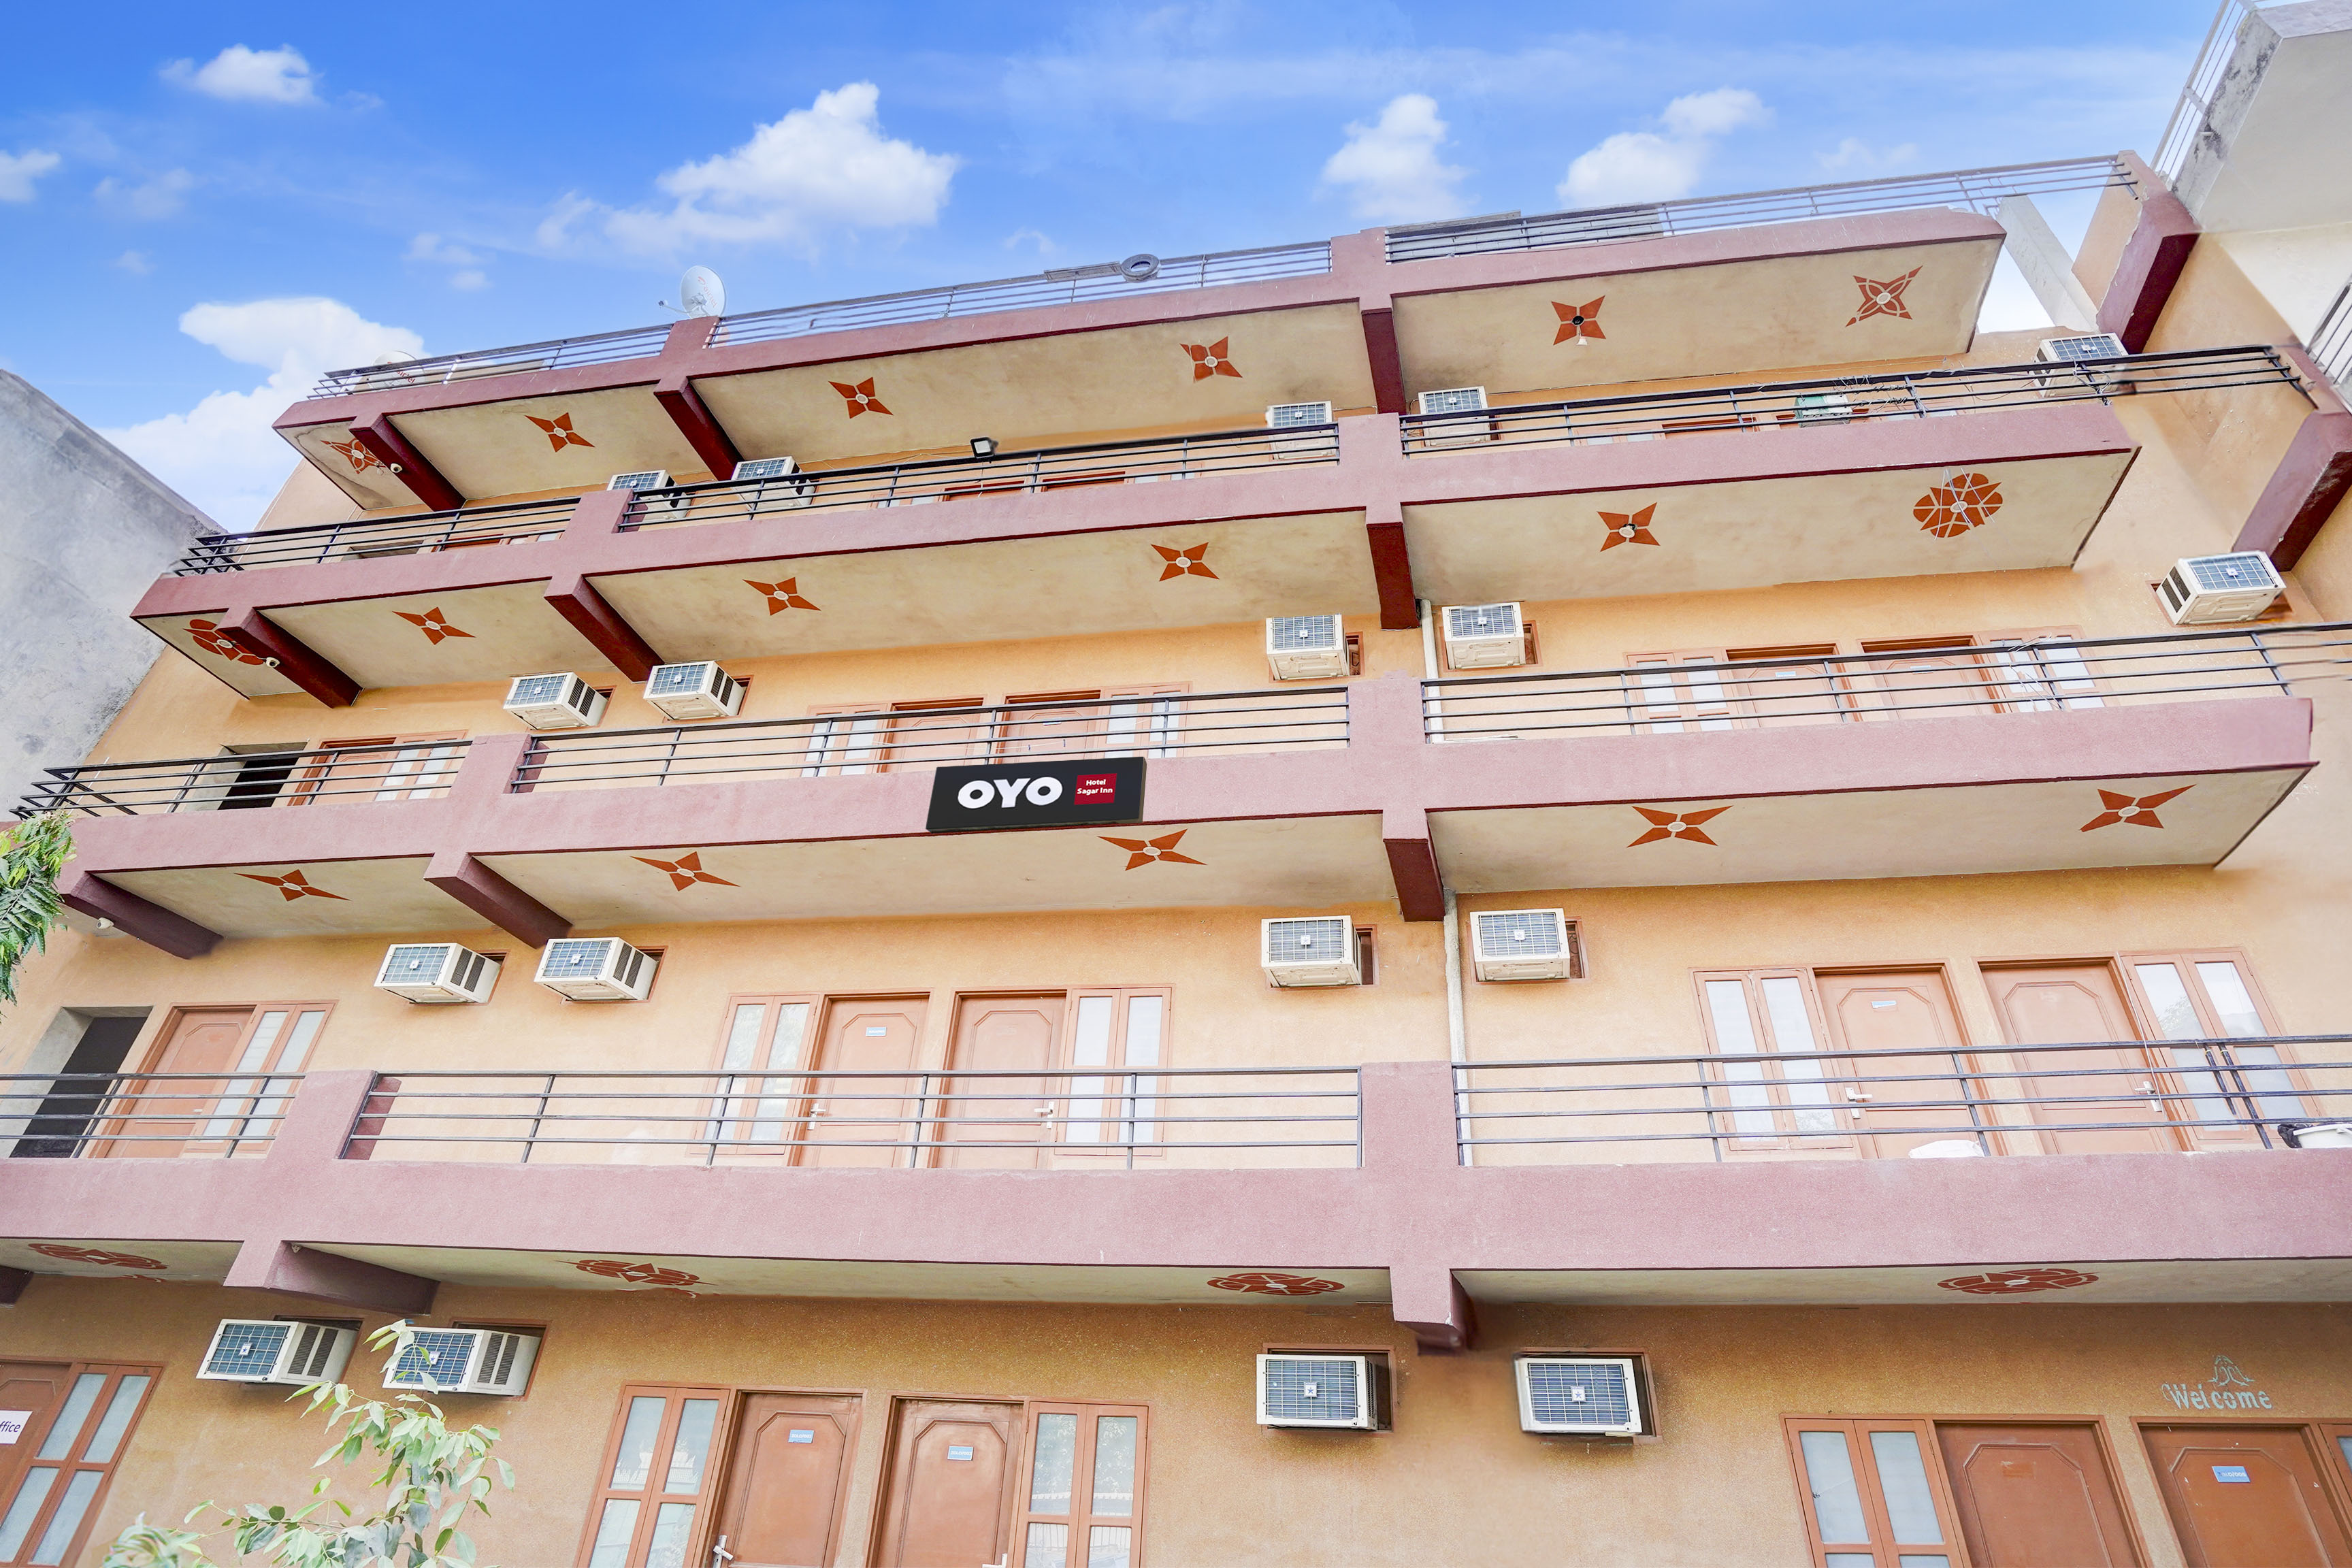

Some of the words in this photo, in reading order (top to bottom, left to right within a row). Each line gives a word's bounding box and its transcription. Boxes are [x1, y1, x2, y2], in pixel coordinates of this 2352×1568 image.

[958, 777, 1063, 809] OYO
[1077, 787, 1099, 796] Sagar
[2161, 1383, 2272, 1410] Welcome
